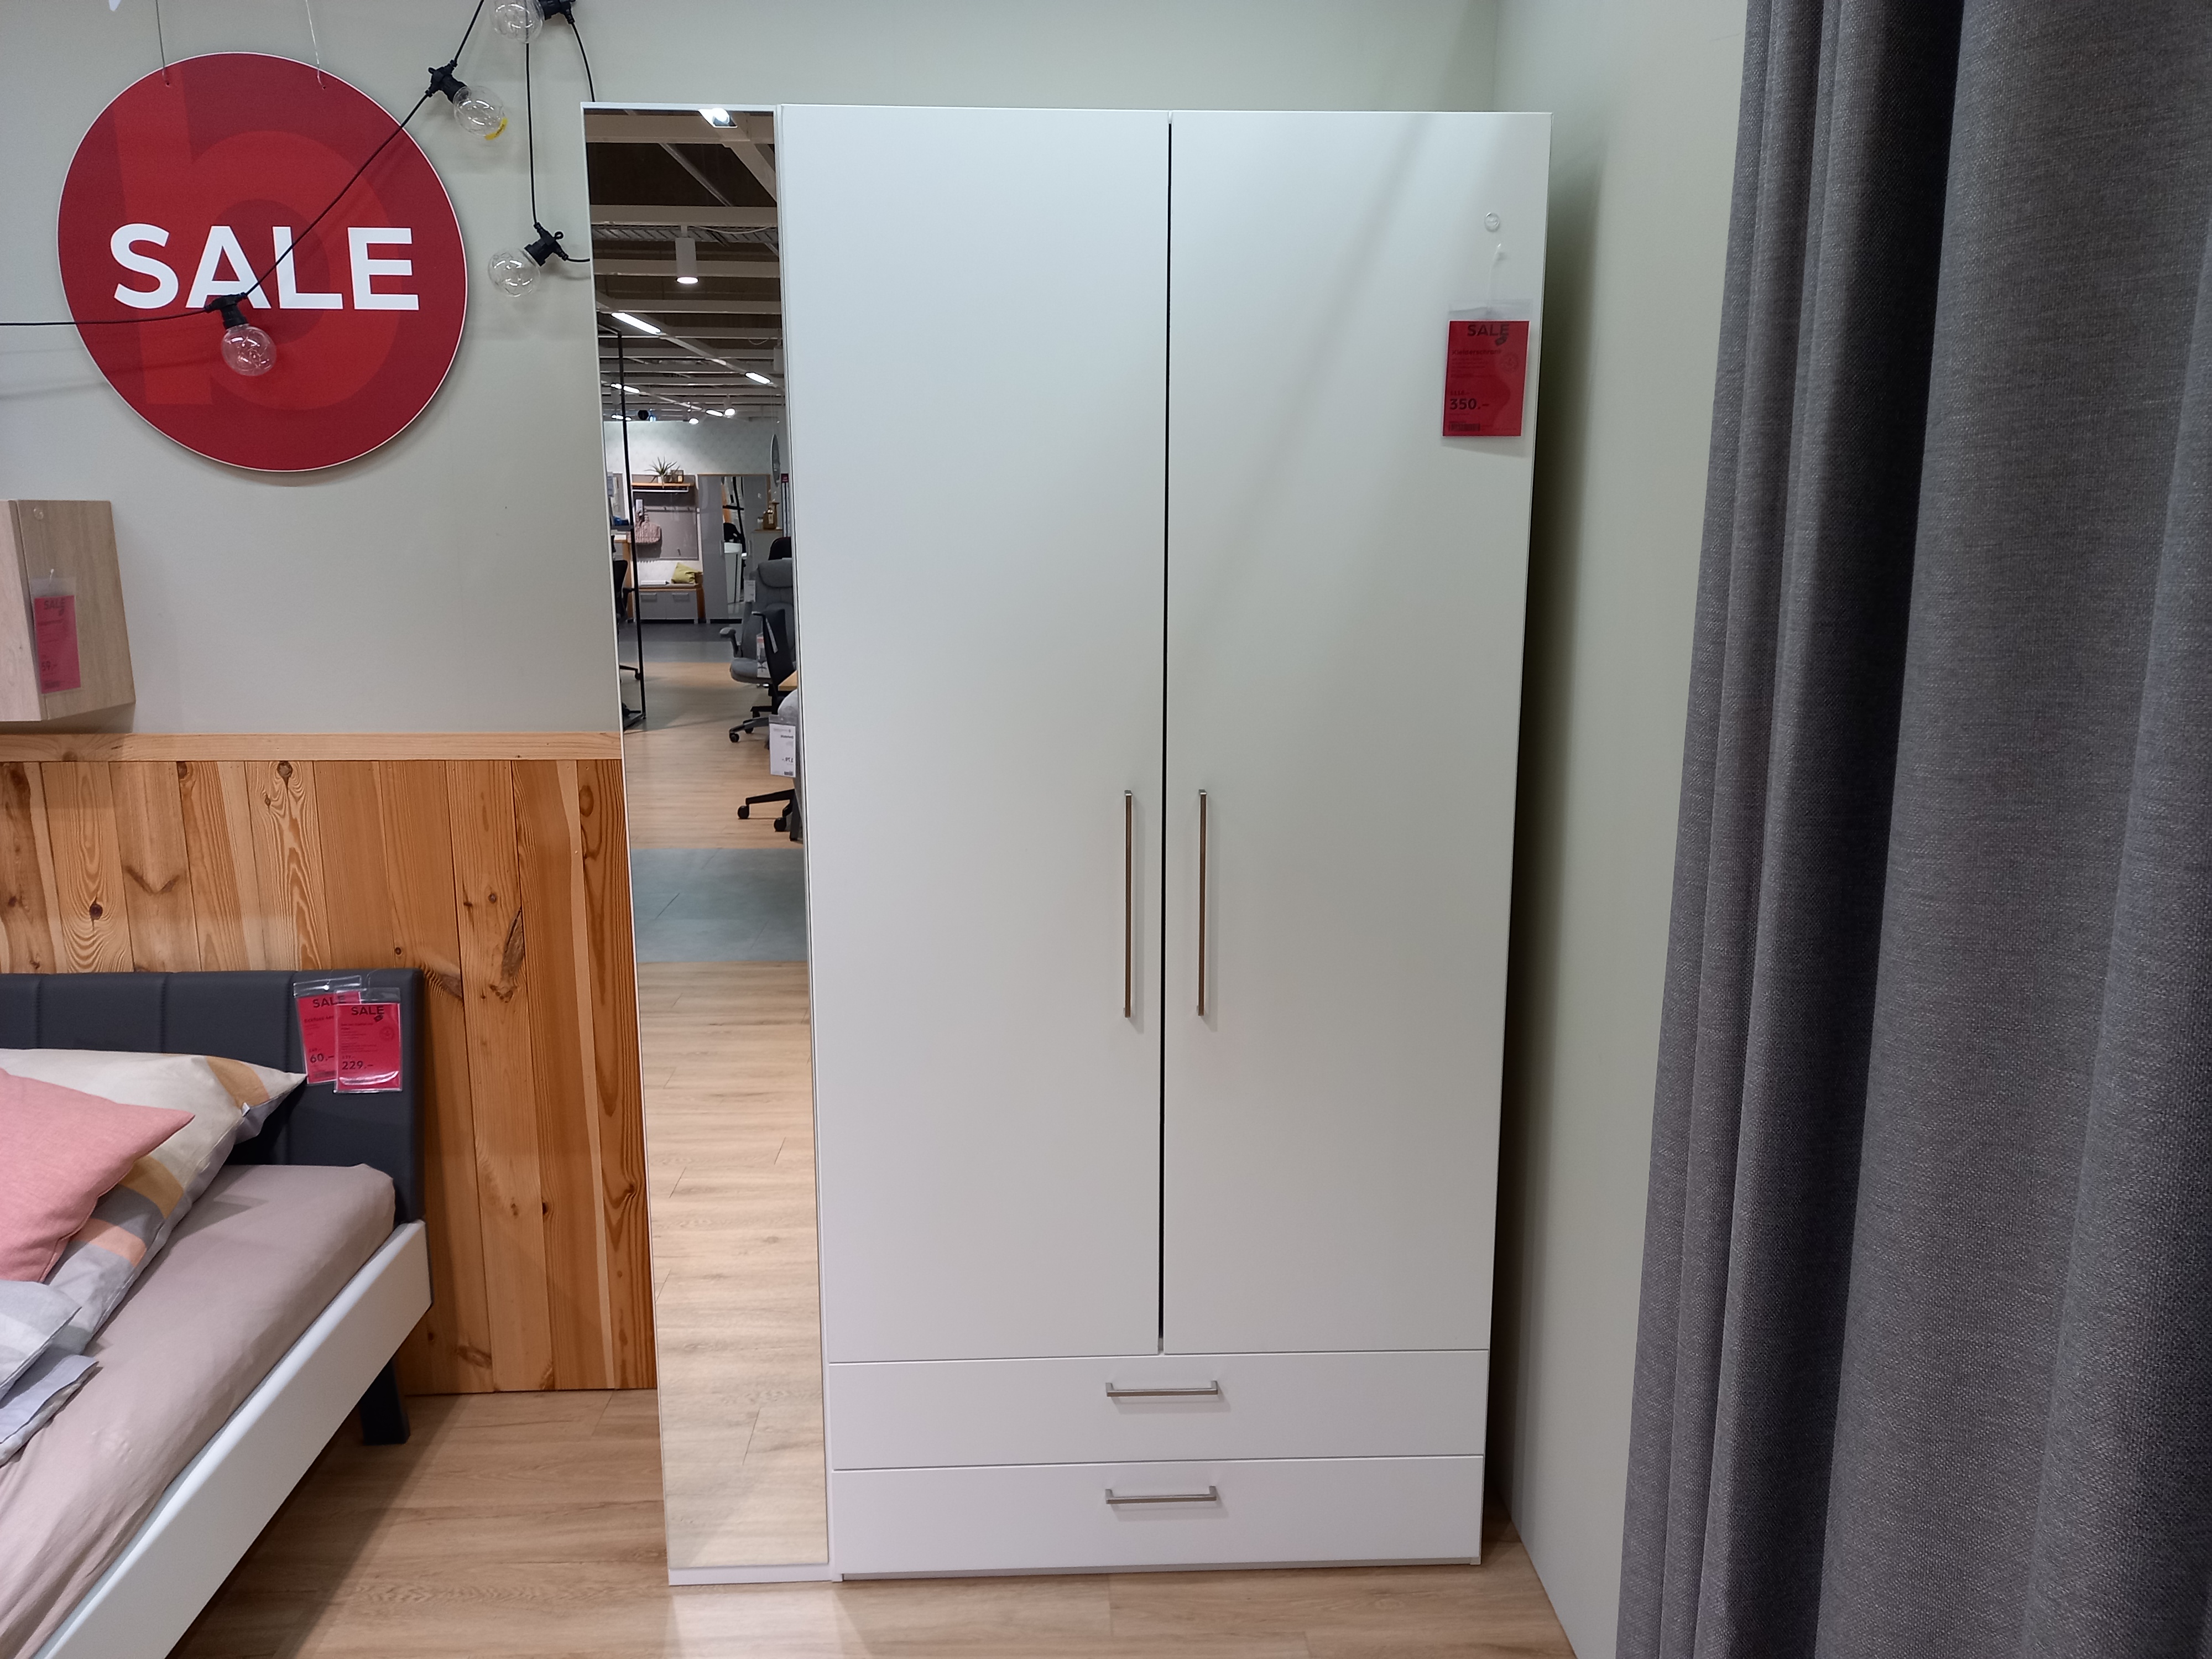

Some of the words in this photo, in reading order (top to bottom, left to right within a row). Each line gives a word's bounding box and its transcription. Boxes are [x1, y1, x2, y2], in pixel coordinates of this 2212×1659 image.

[111, 223, 419, 309] SALE
[1467, 324, 1509, 336] SALE
[1450, 398, 1489, 410] 350.-
[44, 598, 65, 610] SALE
[312, 995, 346, 1008] SALE
[351, 1006, 384, 1016] SALE
[310, 1053, 334, 1063] 60.-
[342, 1061, 373, 1070] 229.-
